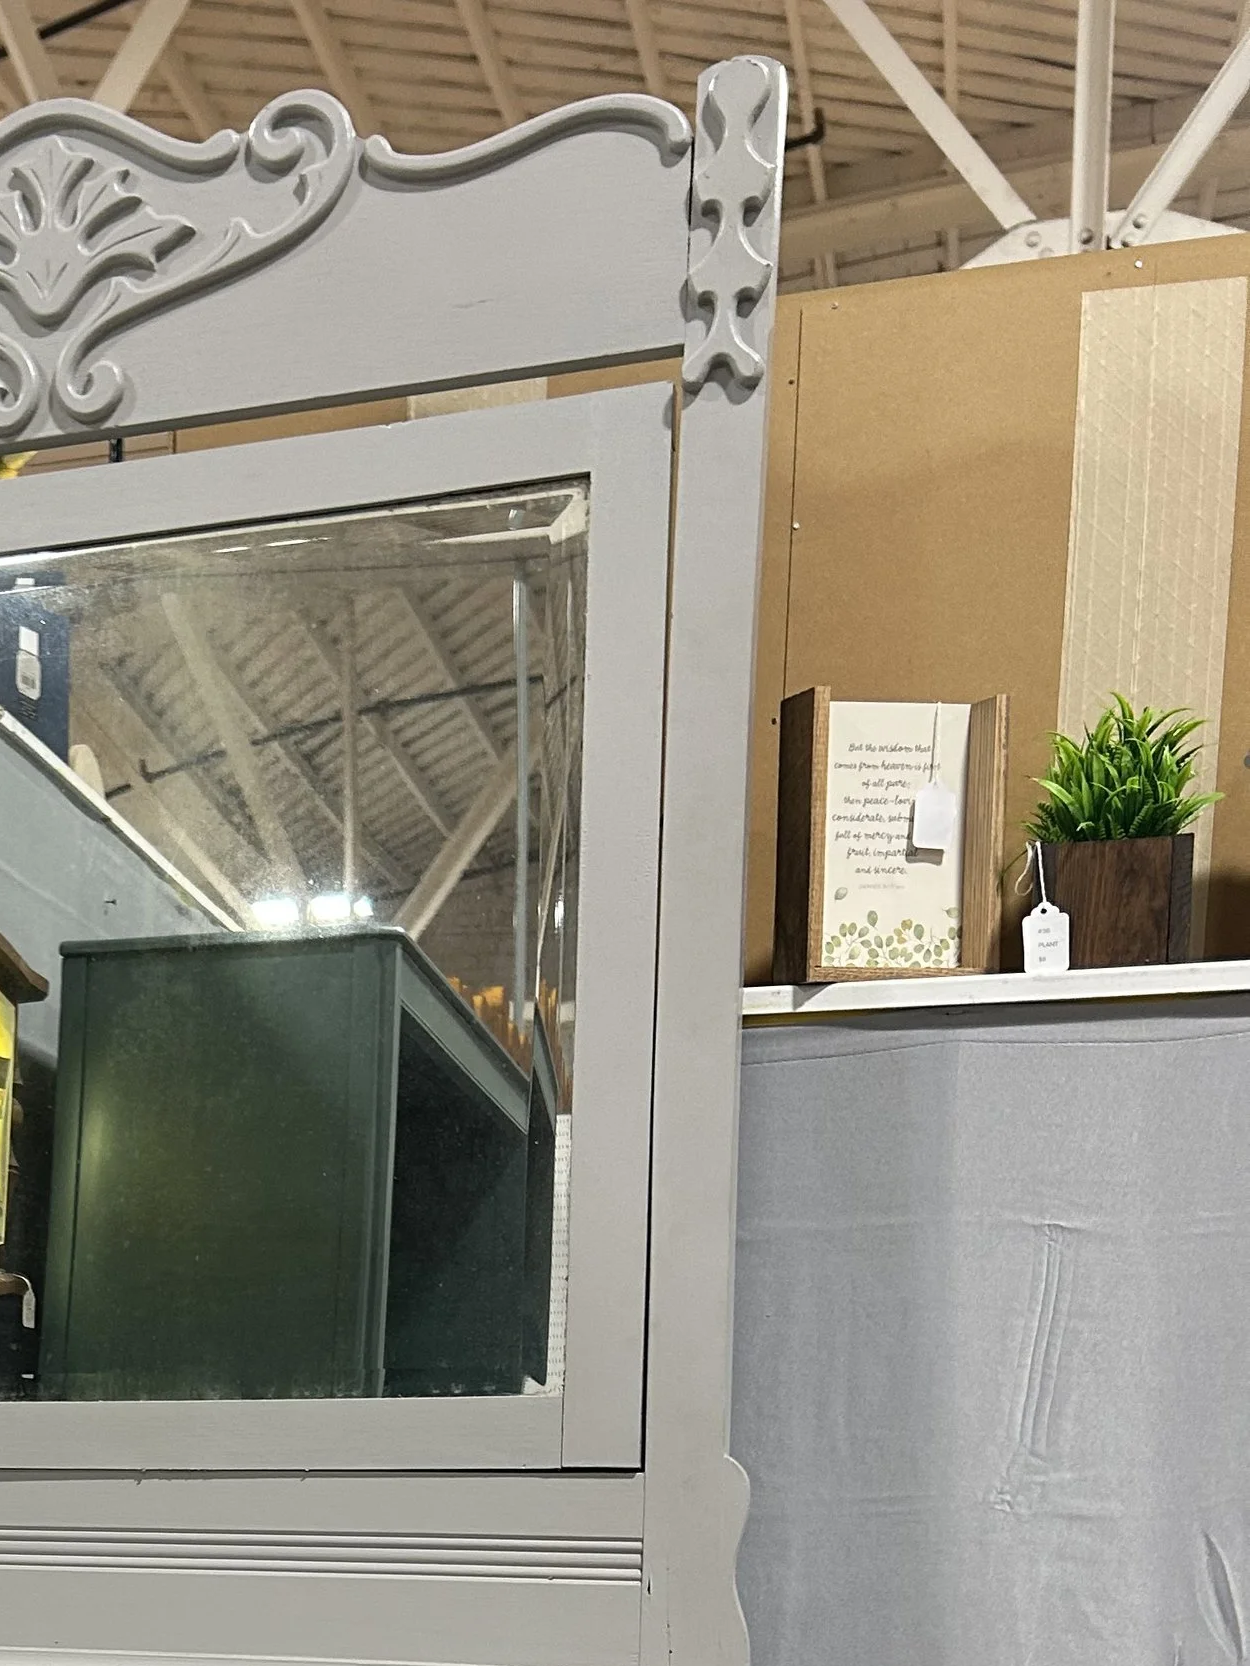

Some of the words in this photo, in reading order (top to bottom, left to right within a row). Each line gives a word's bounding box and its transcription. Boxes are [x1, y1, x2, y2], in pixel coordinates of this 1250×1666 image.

[849, 743, 863, 752] But
[865, 743, 877, 752] the
[878, 743, 913, 753] wisdom
[914, 744, 931, 753] that
[858, 761, 879, 772] from
[861, 779, 870, 790] of
[872, 779, 885, 788] all
[844, 796, 861, 805] then
[835, 830, 851, 842] full
[852, 831, 862, 841] of
[864, 831, 894, 844] mercy
